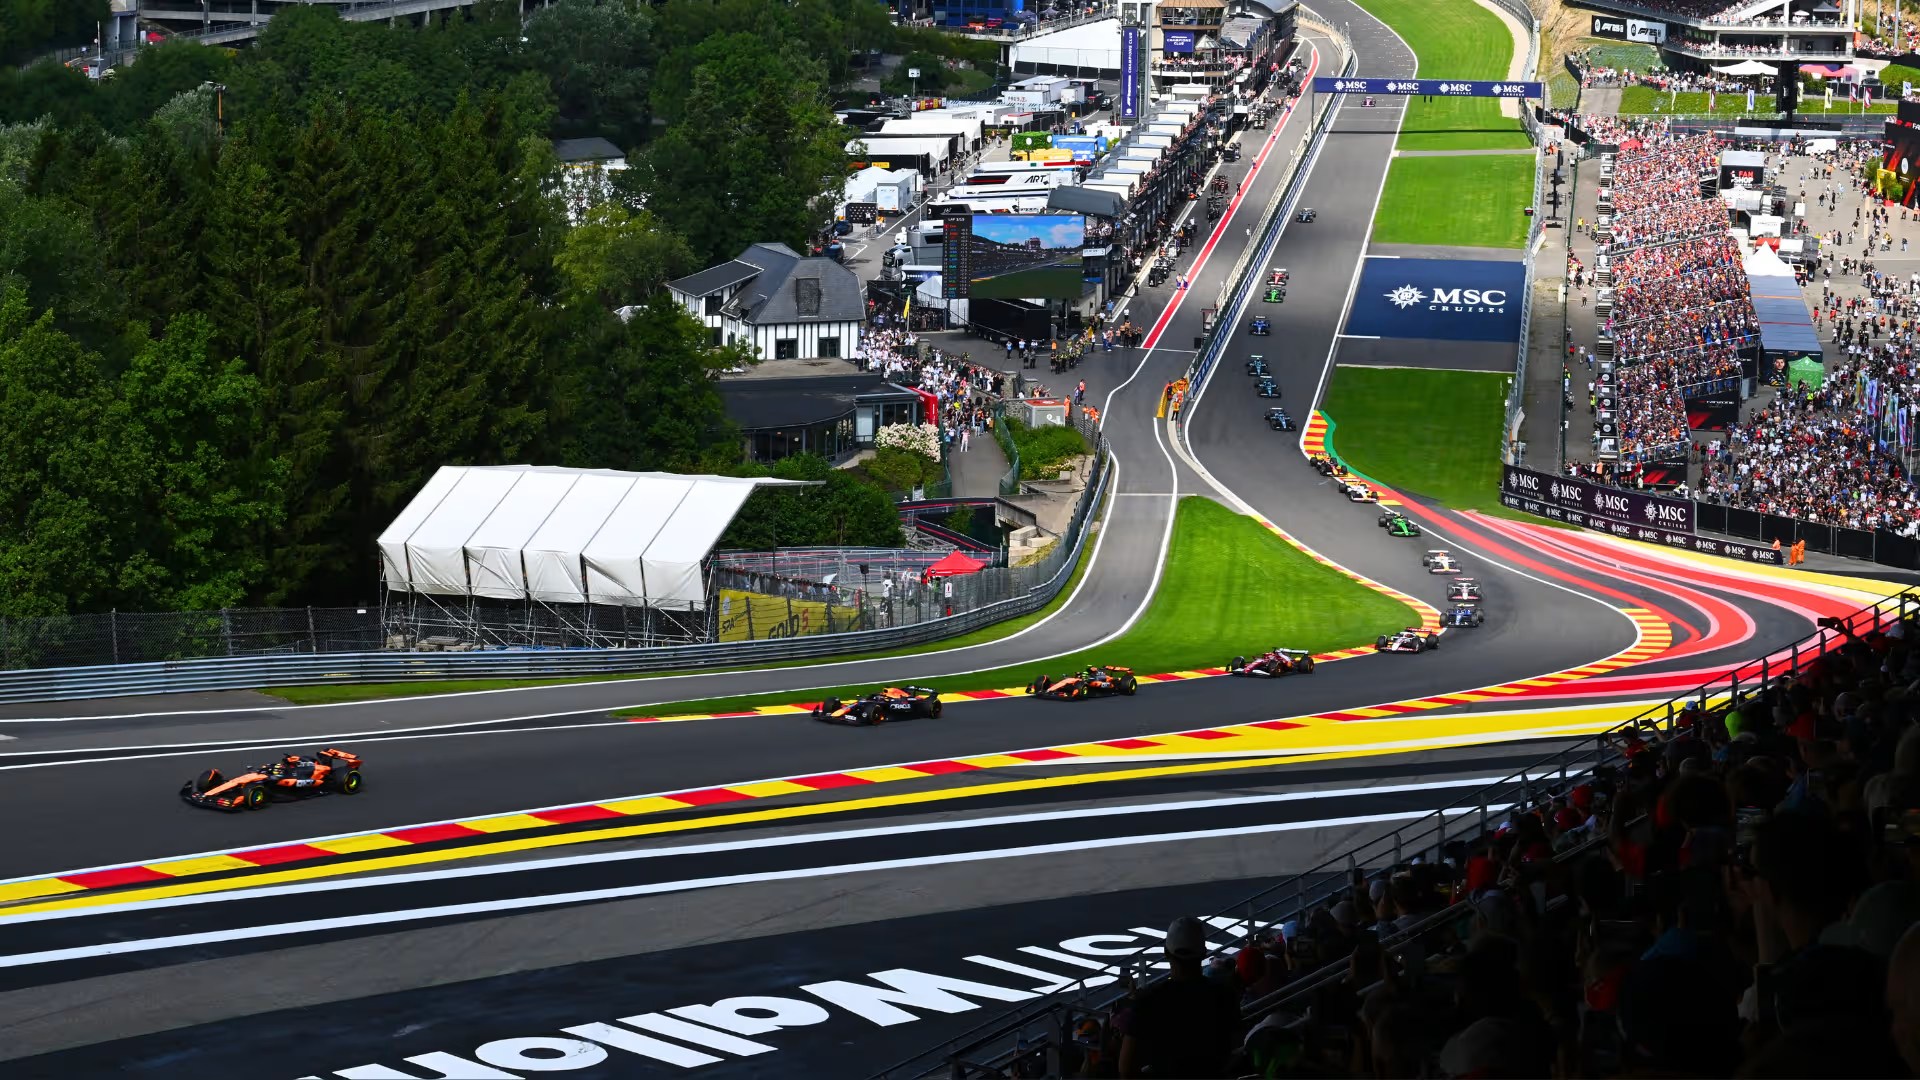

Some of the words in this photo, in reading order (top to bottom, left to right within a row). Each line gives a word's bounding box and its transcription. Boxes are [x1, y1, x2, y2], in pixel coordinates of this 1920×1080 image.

[1345, 81, 1367, 89] MSC
[1398, 82, 1419, 90] MSC
[1024, 175, 1046, 183] ART
[1430, 288, 1506, 306] MSC
[1429, 305, 1504, 313] CRUISES
[1519, 474, 1539, 490] MSC
[1561, 484, 1582, 500] MSC
[1509, 498, 1519, 506] MSC
[1561, 500, 1582, 508] CRUISES
[1605, 495, 1629, 512] MSC
[1529, 503, 1539, 512] MSC
[1551, 508, 1561, 516] MSC
[1572, 513, 1582, 522] MSC
[1606, 510, 1629, 519] CRUISES
[1659, 504, 1686, 522] MSC
[1594, 520, 1606, 528] MSC
[1659, 521, 1687, 529] CRUISES
[1616, 524, 1629, 534] MSC
[1645, 530, 1658, 539] MSC
[1672, 535, 1686, 544] MSC
[1702, 541, 1716, 550] MSC
[1731, 546, 1746, 556] MSC
[1760, 550, 1774, 560] MSC
[722, 617, 735, 634] SPA
[296, 968, 1045, 1080] Wallon
